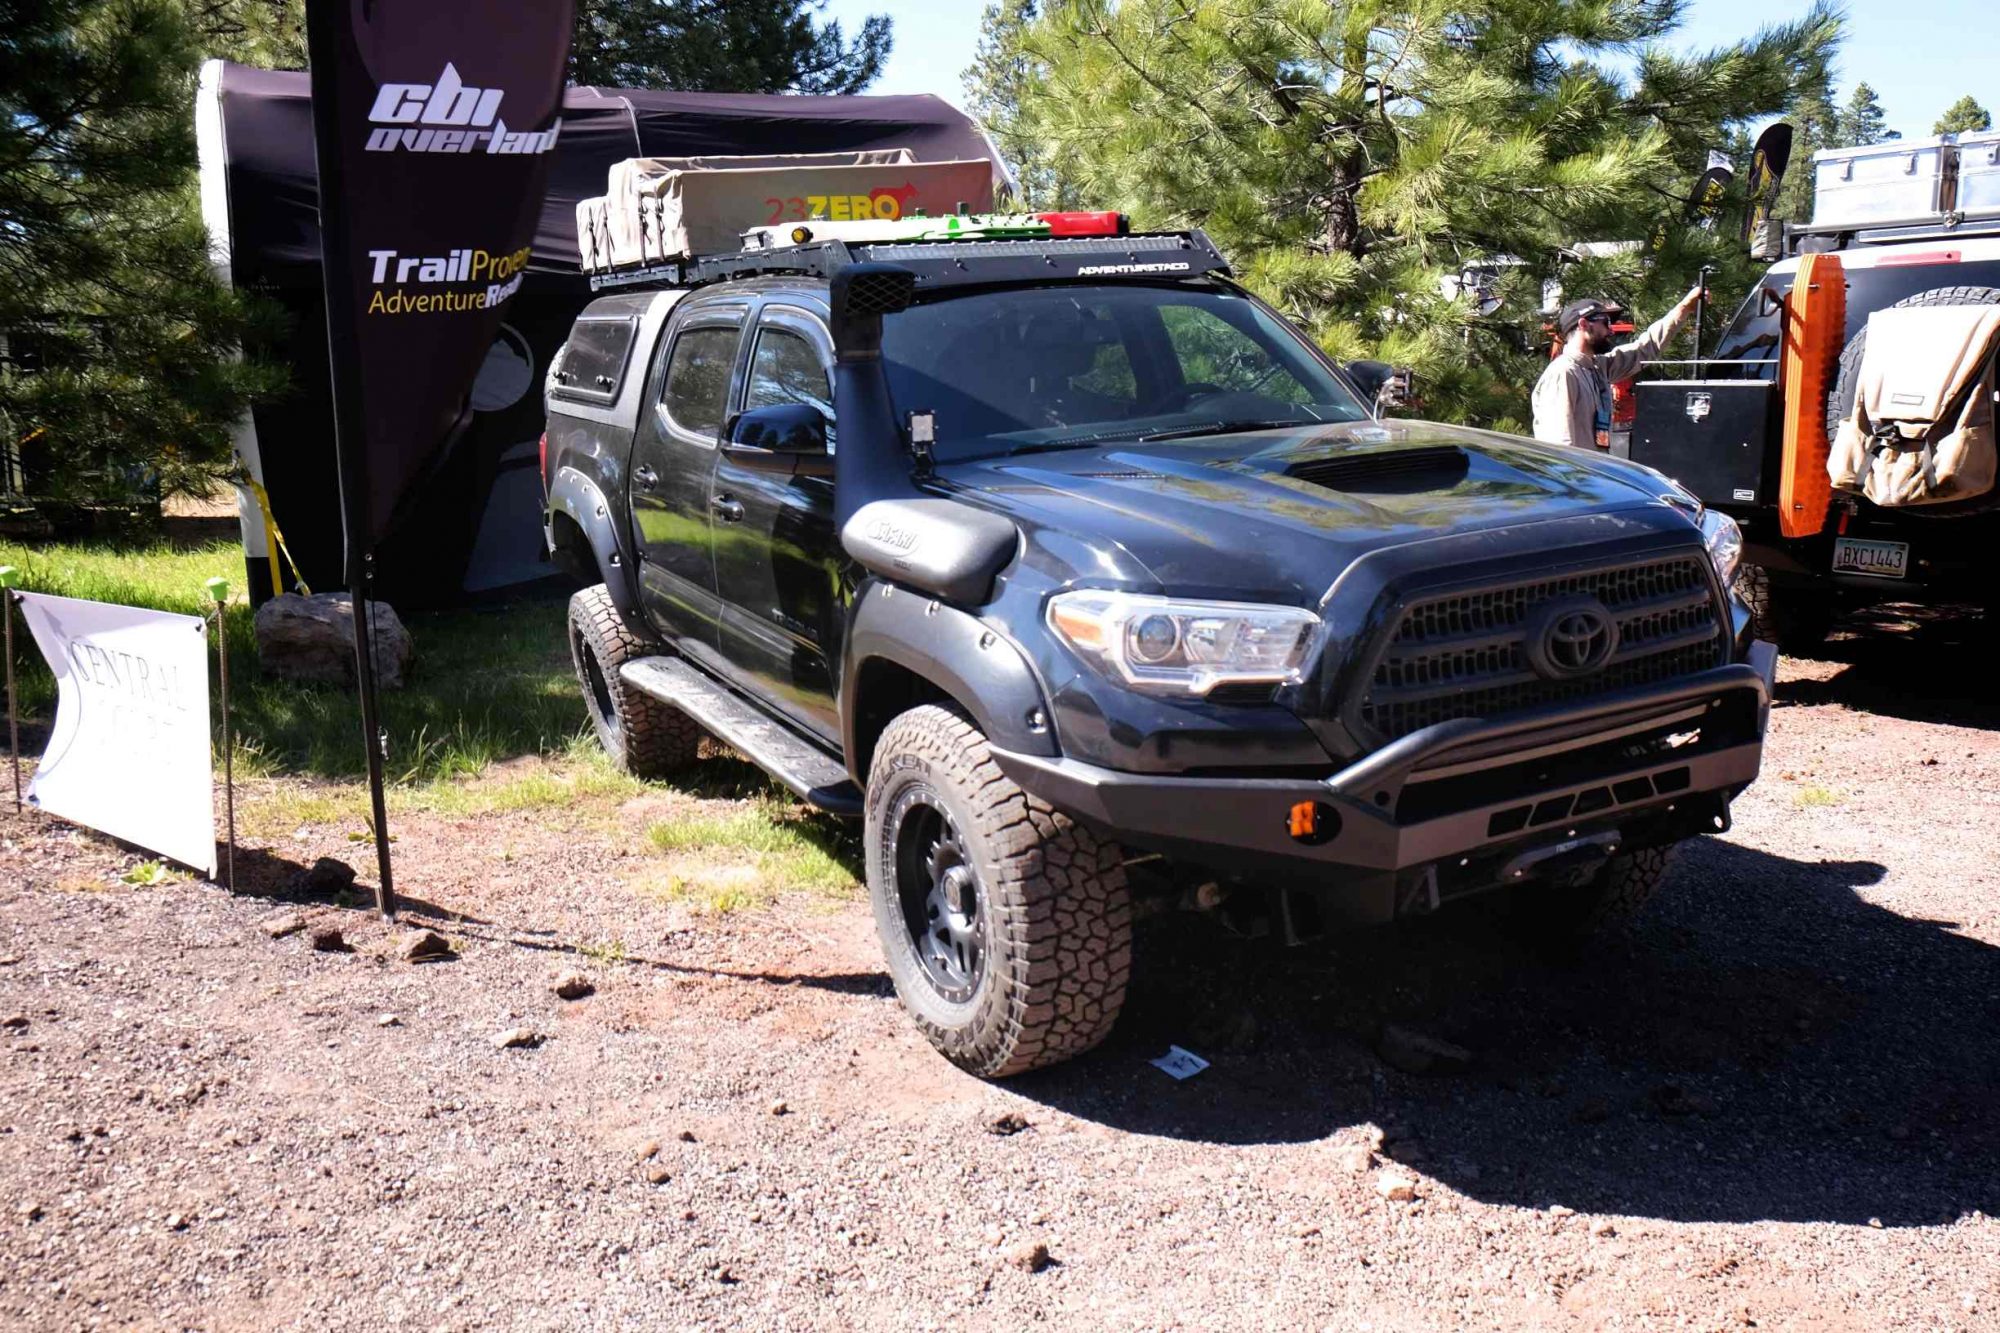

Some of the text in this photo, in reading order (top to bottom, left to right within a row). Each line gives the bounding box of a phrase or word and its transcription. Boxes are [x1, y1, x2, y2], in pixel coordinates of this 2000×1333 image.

[365, 116, 562, 154] overland
[765, 194, 901, 226] 23ZERO
[367, 272, 524, 313] AdventureRe
[1843, 547, 1903, 568] BXC1443
